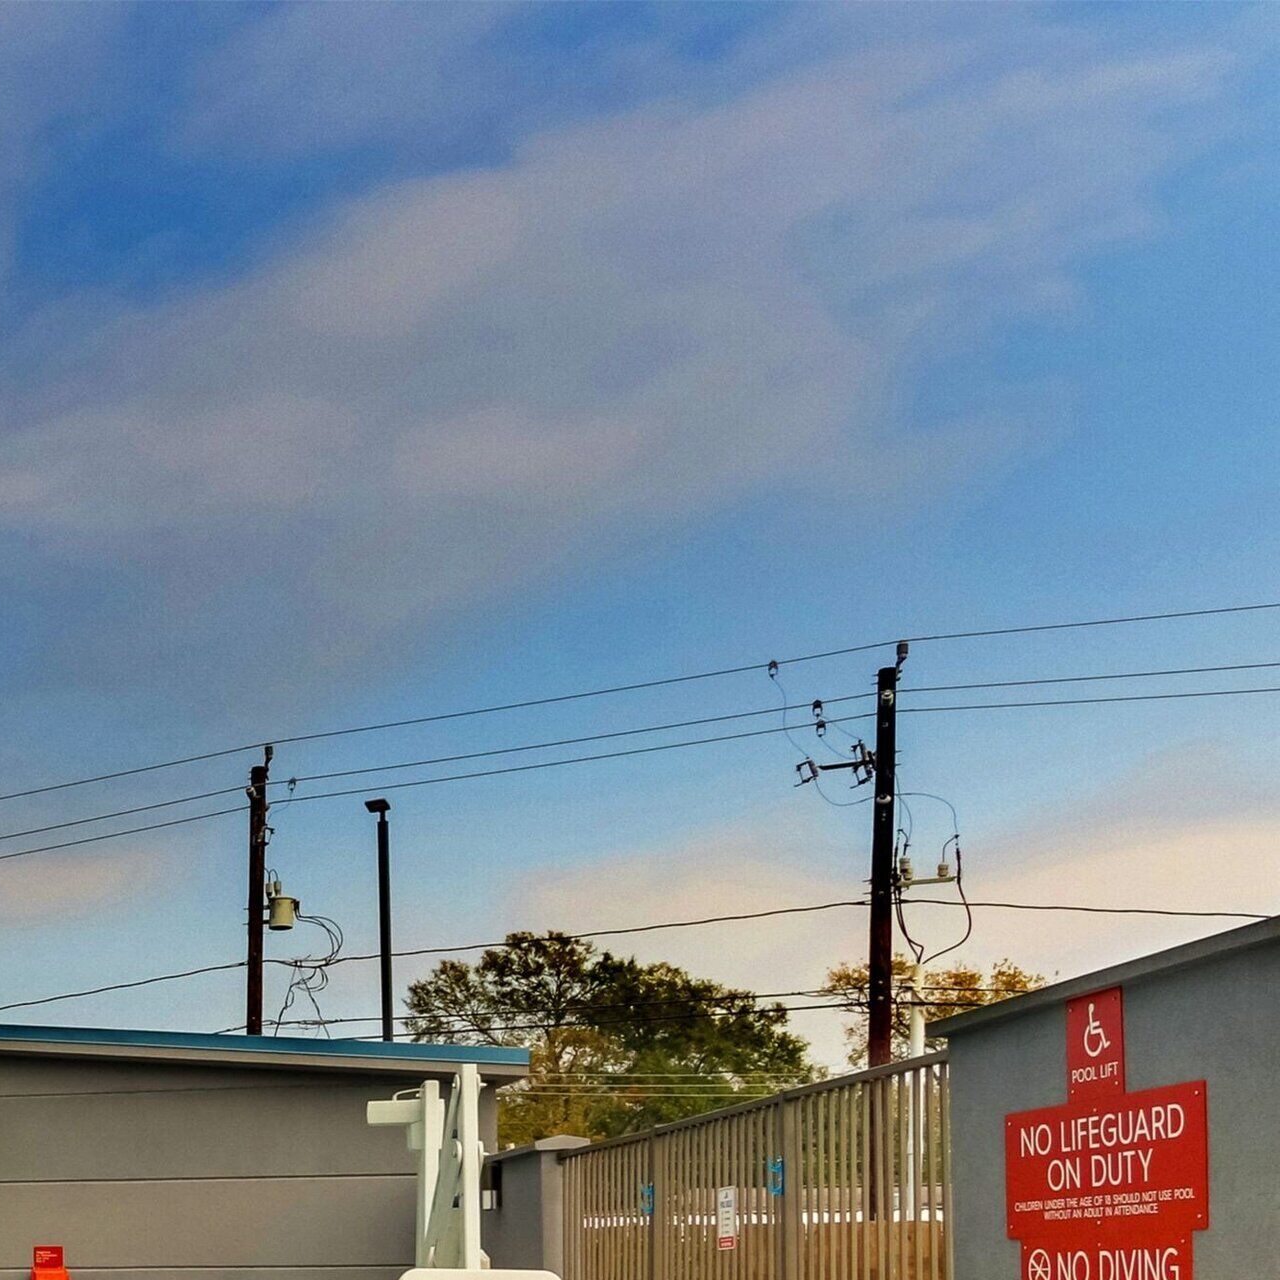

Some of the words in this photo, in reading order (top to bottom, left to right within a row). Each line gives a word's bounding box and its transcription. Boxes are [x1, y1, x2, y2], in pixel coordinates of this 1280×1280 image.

[1072, 1067, 1097, 1083] POOL
[1100, 1061, 1119, 1079] LIFT
[1020, 1124, 1052, 1158] NO
[1060, 1103, 1185, 1152] LIFEGUARD
[1047, 1157, 1081, 1191] ON
[1091, 1148, 1154, 1187] DUTY
[1014, 1200, 1043, 1212] CHILDREN
[1044, 1198, 1065, 1210] UNDER
[1066, 1197, 1078, 1208] THE
[1079, 1196, 1093, 1207] AGE
[1093, 1195, 1103, 1206] OF
[1112, 1192, 1140, 1204] SHOULD
[1142, 1190, 1157, 1202] NOT
[1158, 1189, 1172, 1201] USE
[1173, 1187, 1195, 1200] POOL
[1044, 1209, 1071, 1220] WITHOUT
[1072, 1208, 1082, 1219] AN
[1083, 1207, 1104, 1218] ADULT
[1105, 1206, 1113, 1217] IN
[1114, 1202, 1158, 1216] ATTENDANCE
